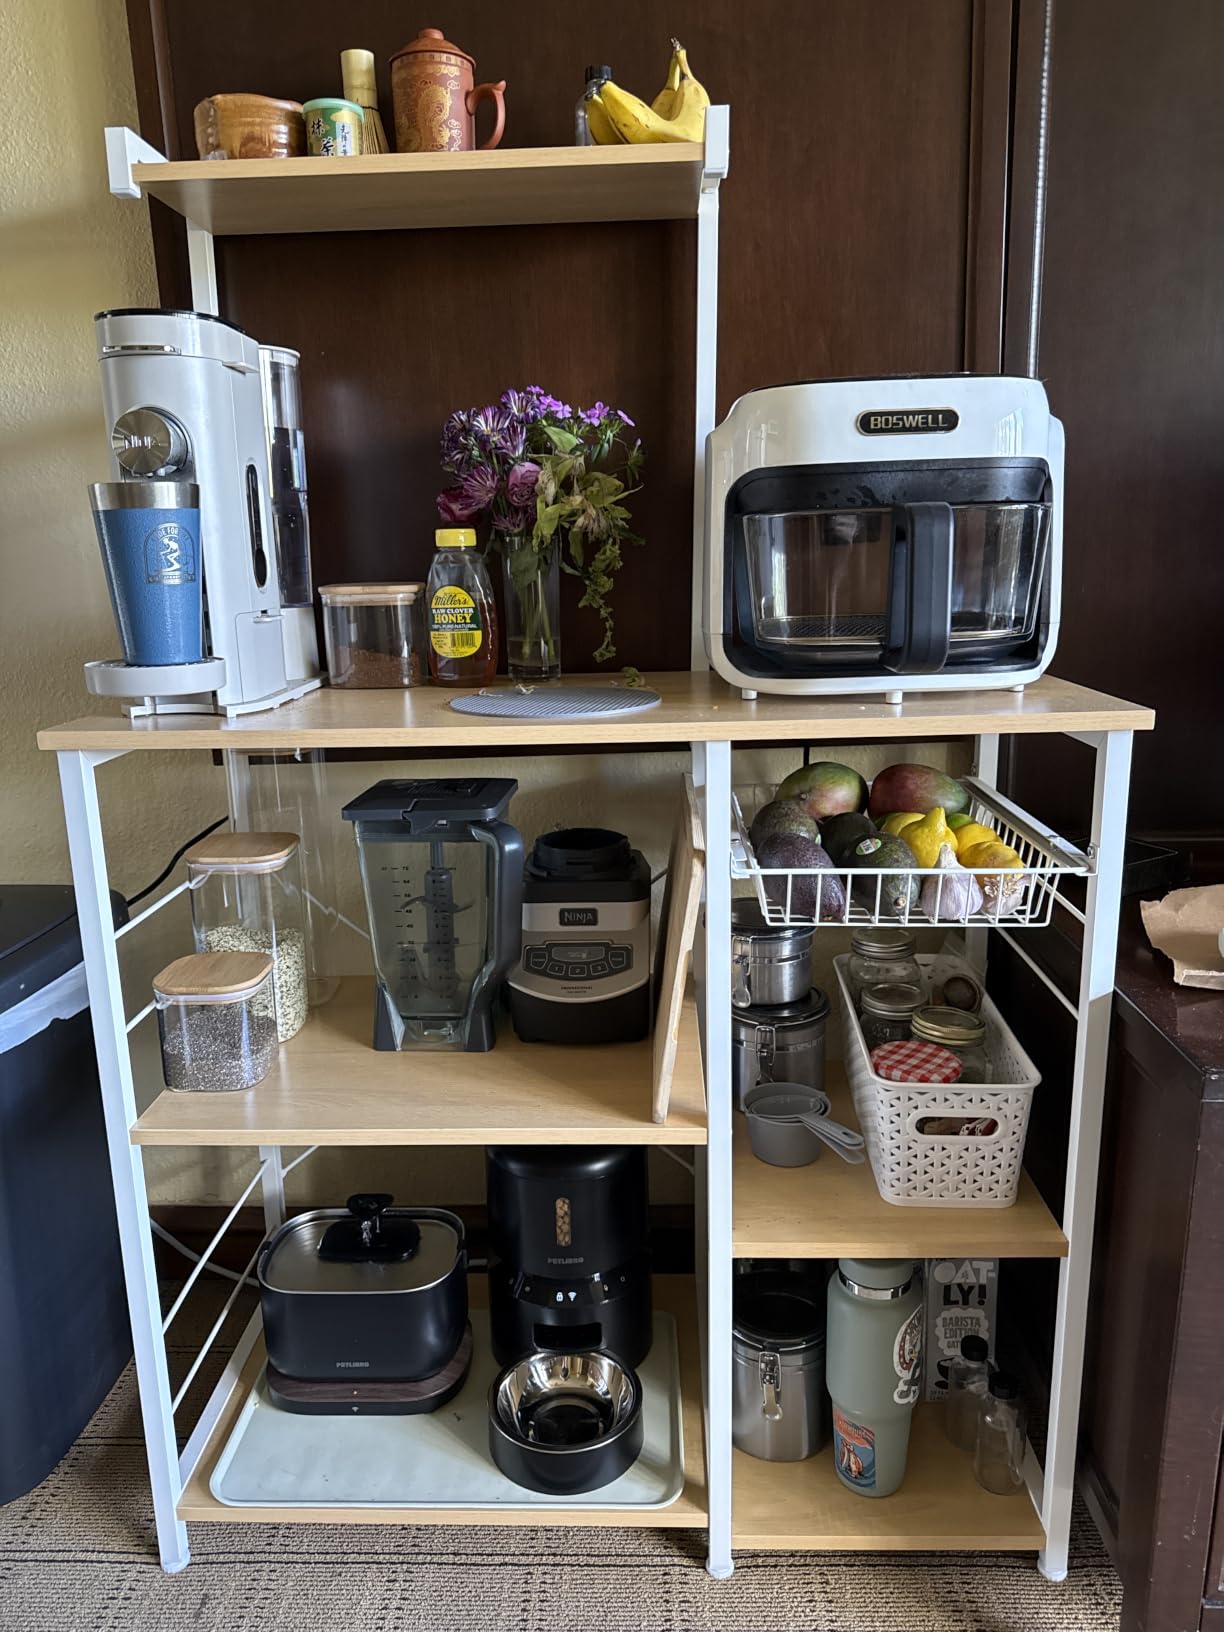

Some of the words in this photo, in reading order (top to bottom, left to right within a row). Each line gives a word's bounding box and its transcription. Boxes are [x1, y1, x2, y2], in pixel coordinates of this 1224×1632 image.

[870, 414, 949, 430] BOSWELL
[434, 614, 472, 623] HONEY
[564, 911, 594, 923] NINJA
[943, 1283, 987, 1306] LY!
[942, 1316, 981, 1329] BARISTA
